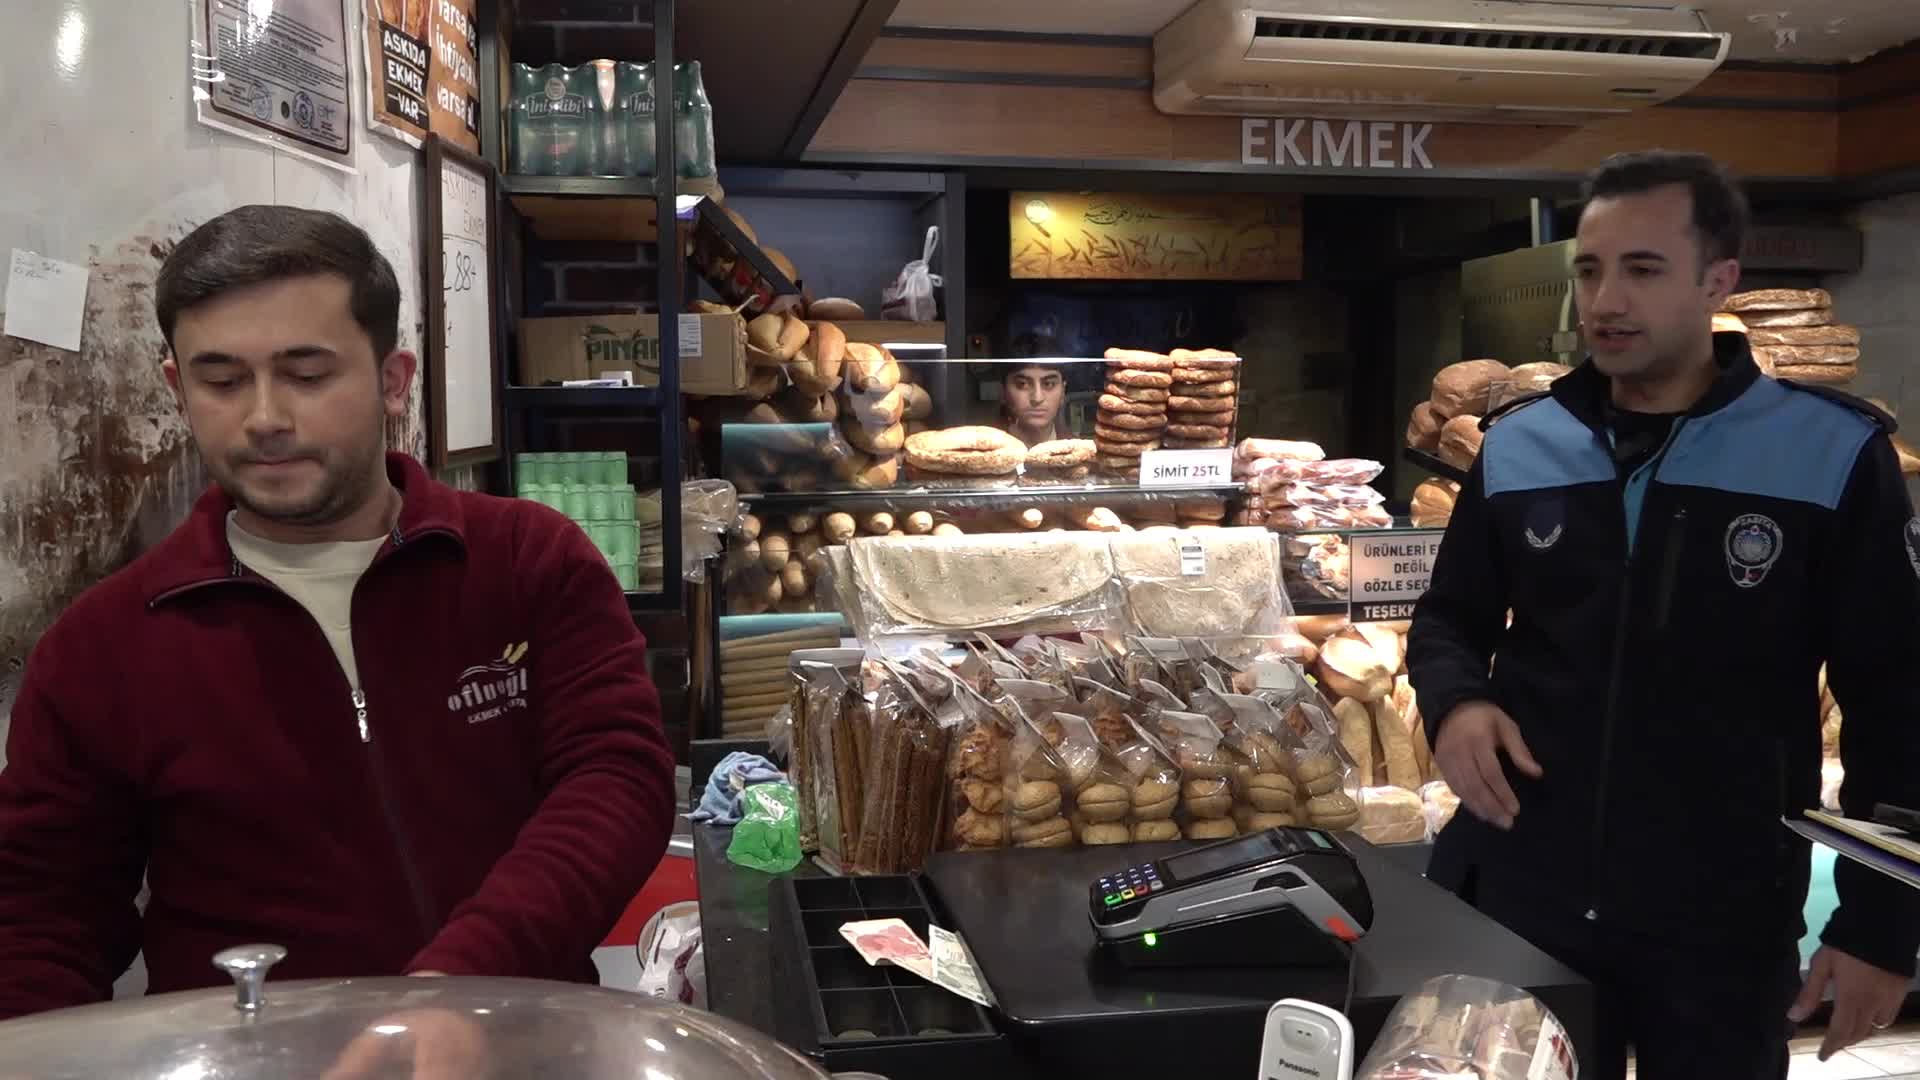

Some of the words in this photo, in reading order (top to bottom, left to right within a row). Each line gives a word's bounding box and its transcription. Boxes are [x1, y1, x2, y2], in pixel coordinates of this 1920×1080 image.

[383, 30, 426, 69] ASKIDA
[387, 60, 423, 96] EKMEK
[398, 92, 420, 120] VAR
[1241, 118, 1433, 169] EKMEK
[1153, 464, 1189, 478] SİMİT
[1192, 465, 1220, 477] 25TL
[1363, 541, 1426, 558] ÜRÜNLERİ
[1394, 559, 1430, 574] DEĞİL
[1364, 578, 1403, 593] GÖZLE
